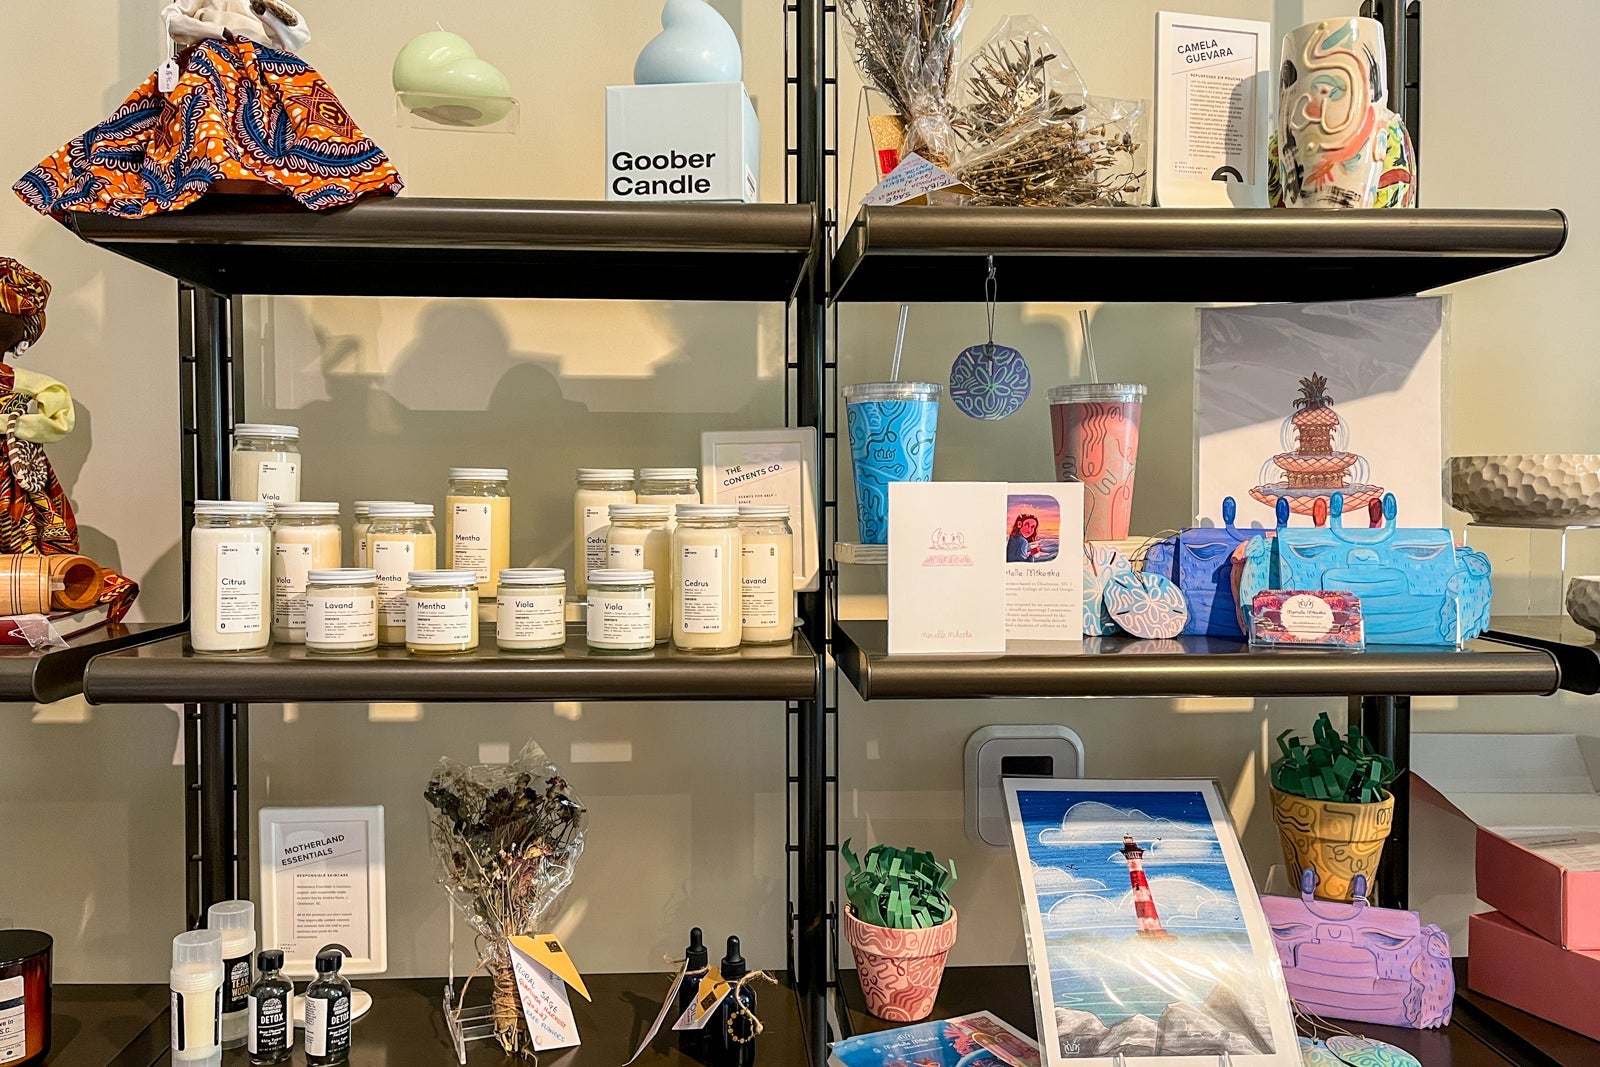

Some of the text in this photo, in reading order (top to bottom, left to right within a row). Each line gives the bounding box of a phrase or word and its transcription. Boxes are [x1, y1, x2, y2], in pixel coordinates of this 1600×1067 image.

[1178, 39, 1218, 54] CAMELA
[1186, 48, 1234, 64] GUEVARA
[612, 150, 716, 171] Goober
[612, 175, 711, 196] Candle
[724, 464, 783, 486] CONTENTS CO.
[725, 466, 742, 476] THE
[222, 578, 246, 586] Citrus
[418, 602, 446, 610] Mentha
[604, 602, 623, 610] Viola
[284, 834, 345, 855] MOTHERLAND
[282, 848, 334, 866] ESSENTIALS
[232, 978, 249, 989] TEAK
[515, 962, 558, 1014] FLORAL SAGE
[232, 986, 250, 997] WOOD
[261, 1013, 284, 1024] DETOX
[331, 1011, 350, 1024] DETOX
